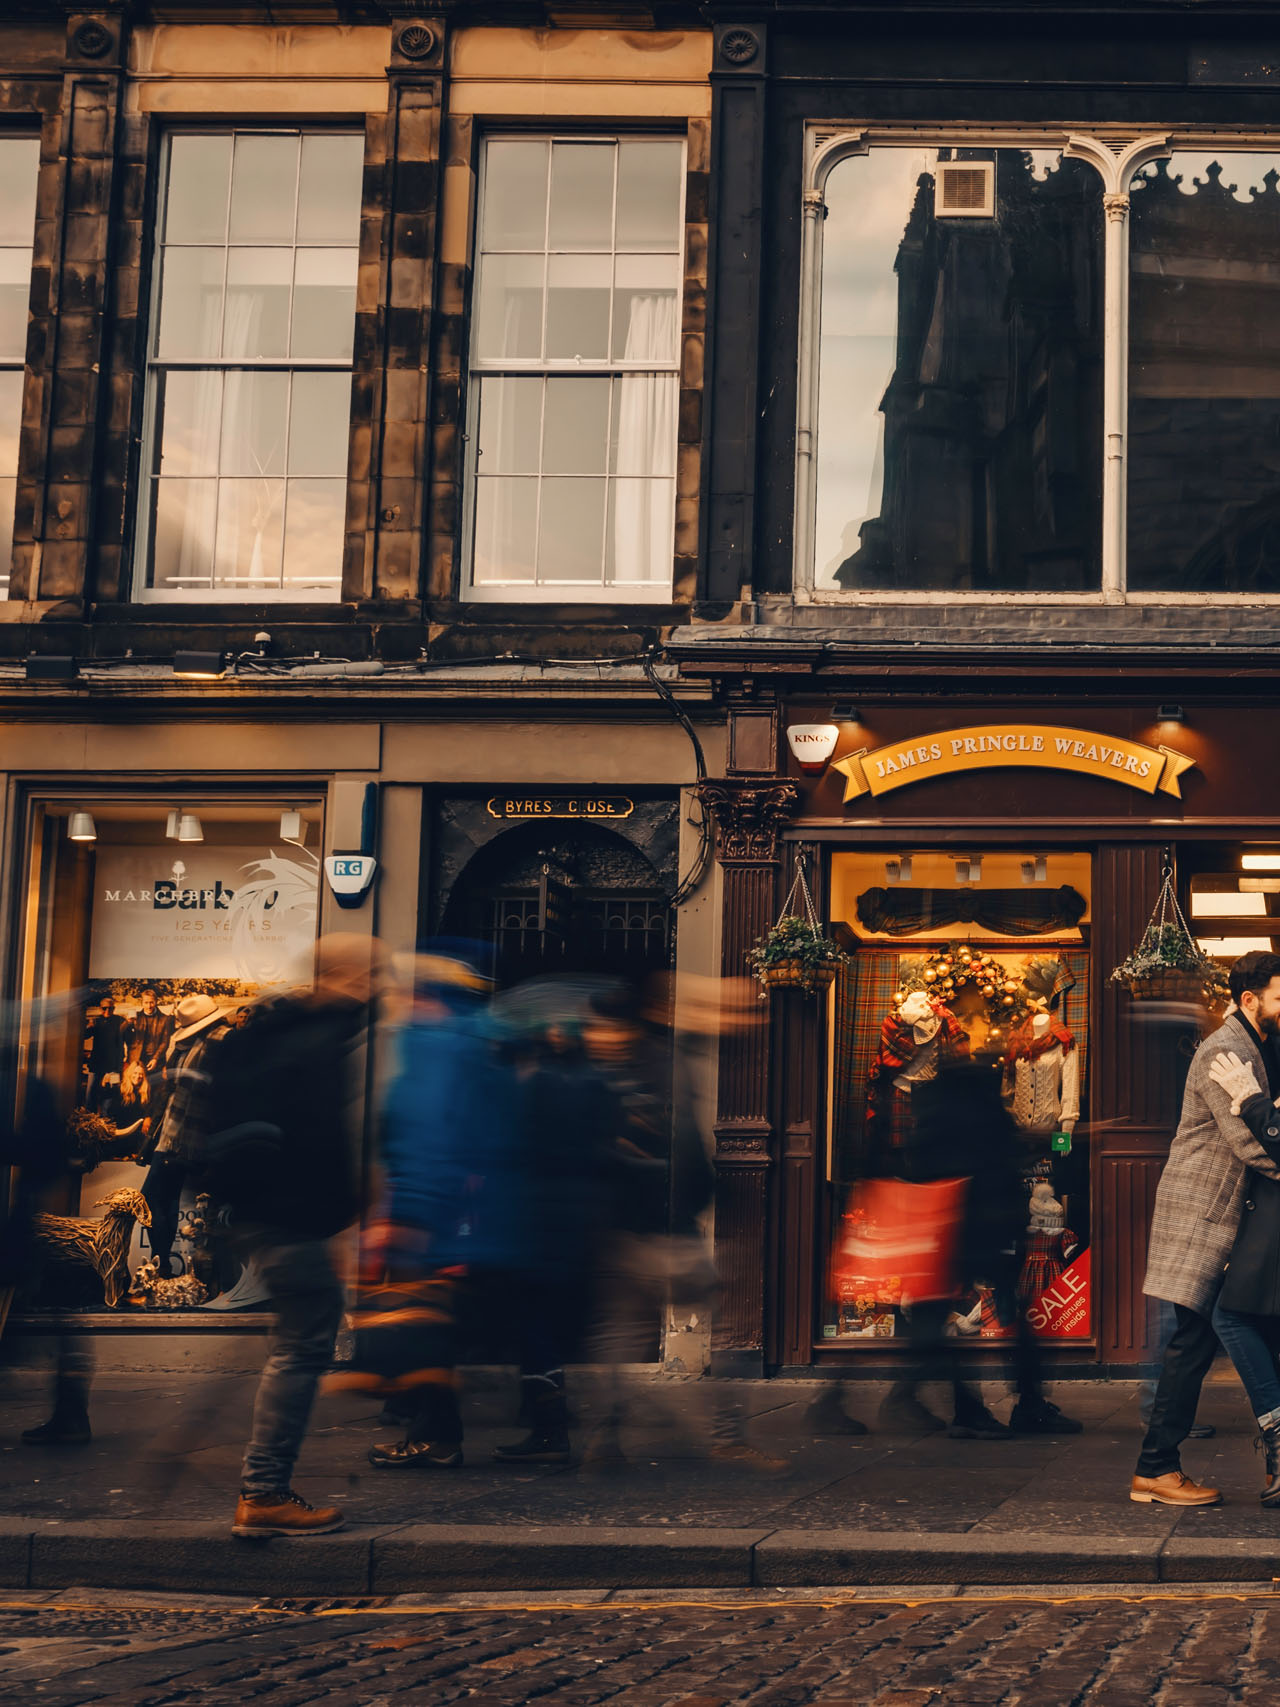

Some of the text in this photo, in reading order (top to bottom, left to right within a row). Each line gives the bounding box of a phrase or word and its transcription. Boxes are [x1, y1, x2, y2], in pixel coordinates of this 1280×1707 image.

[794, 734, 830, 743] KINGS
[876, 734, 1152, 778] JAMES PRINGLE WEAVERS
[505, 800, 616, 813] BYRES COSE
[175, 920, 272, 931] 125 YERS
[1026, 1268, 1087, 1330] SALE
[1051, 1296, 1086, 1331] continues
[1063, 1309, 1087, 1332] inside
